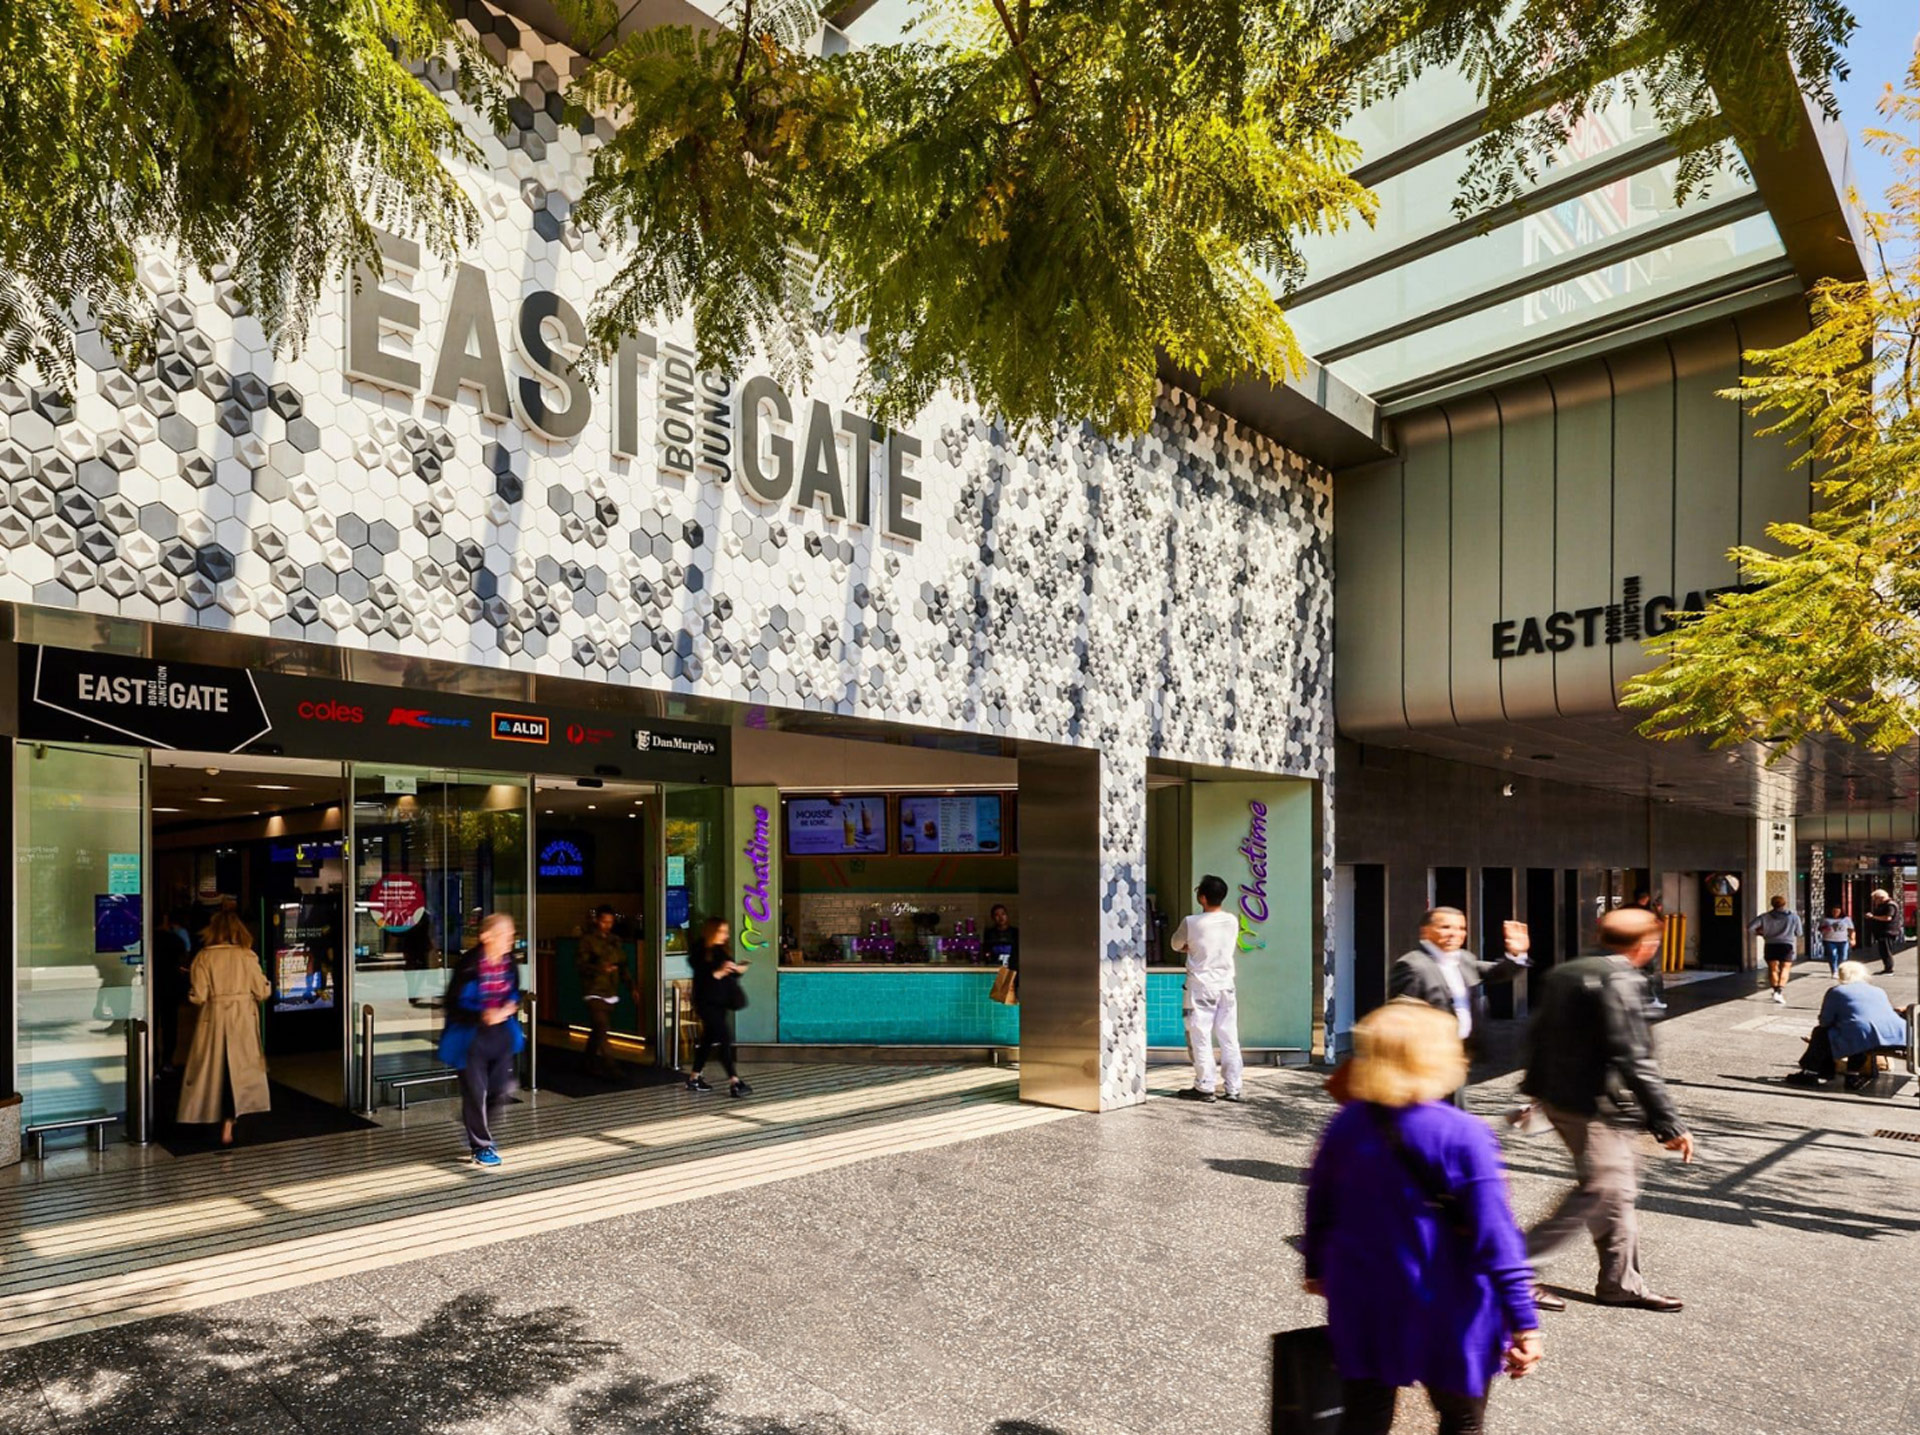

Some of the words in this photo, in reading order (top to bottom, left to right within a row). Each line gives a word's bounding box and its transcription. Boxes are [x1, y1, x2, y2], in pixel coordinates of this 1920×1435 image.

[345, 220, 658, 457] EAST
[663, 341, 695, 473] BONDI
[735, 374, 924, 543] GATE
[1492, 606, 1604, 660] EAST
[1605, 603, 1622, 645] BONDI
[1623, 575, 1641, 642] JUNCTION
[78, 673, 147, 705] EAST
[148, 680, 158, 707] BONDI
[157, 665, 168, 708] JUNCTION
[168, 682, 229, 713] GATE
[297, 699, 365, 723] coles
[512, 721, 544, 736] ALDI
[796, 809, 833, 819] MOUSSE
[743, 804, 771, 923] Chatime
[1239, 799, 1269, 923] Chatime
